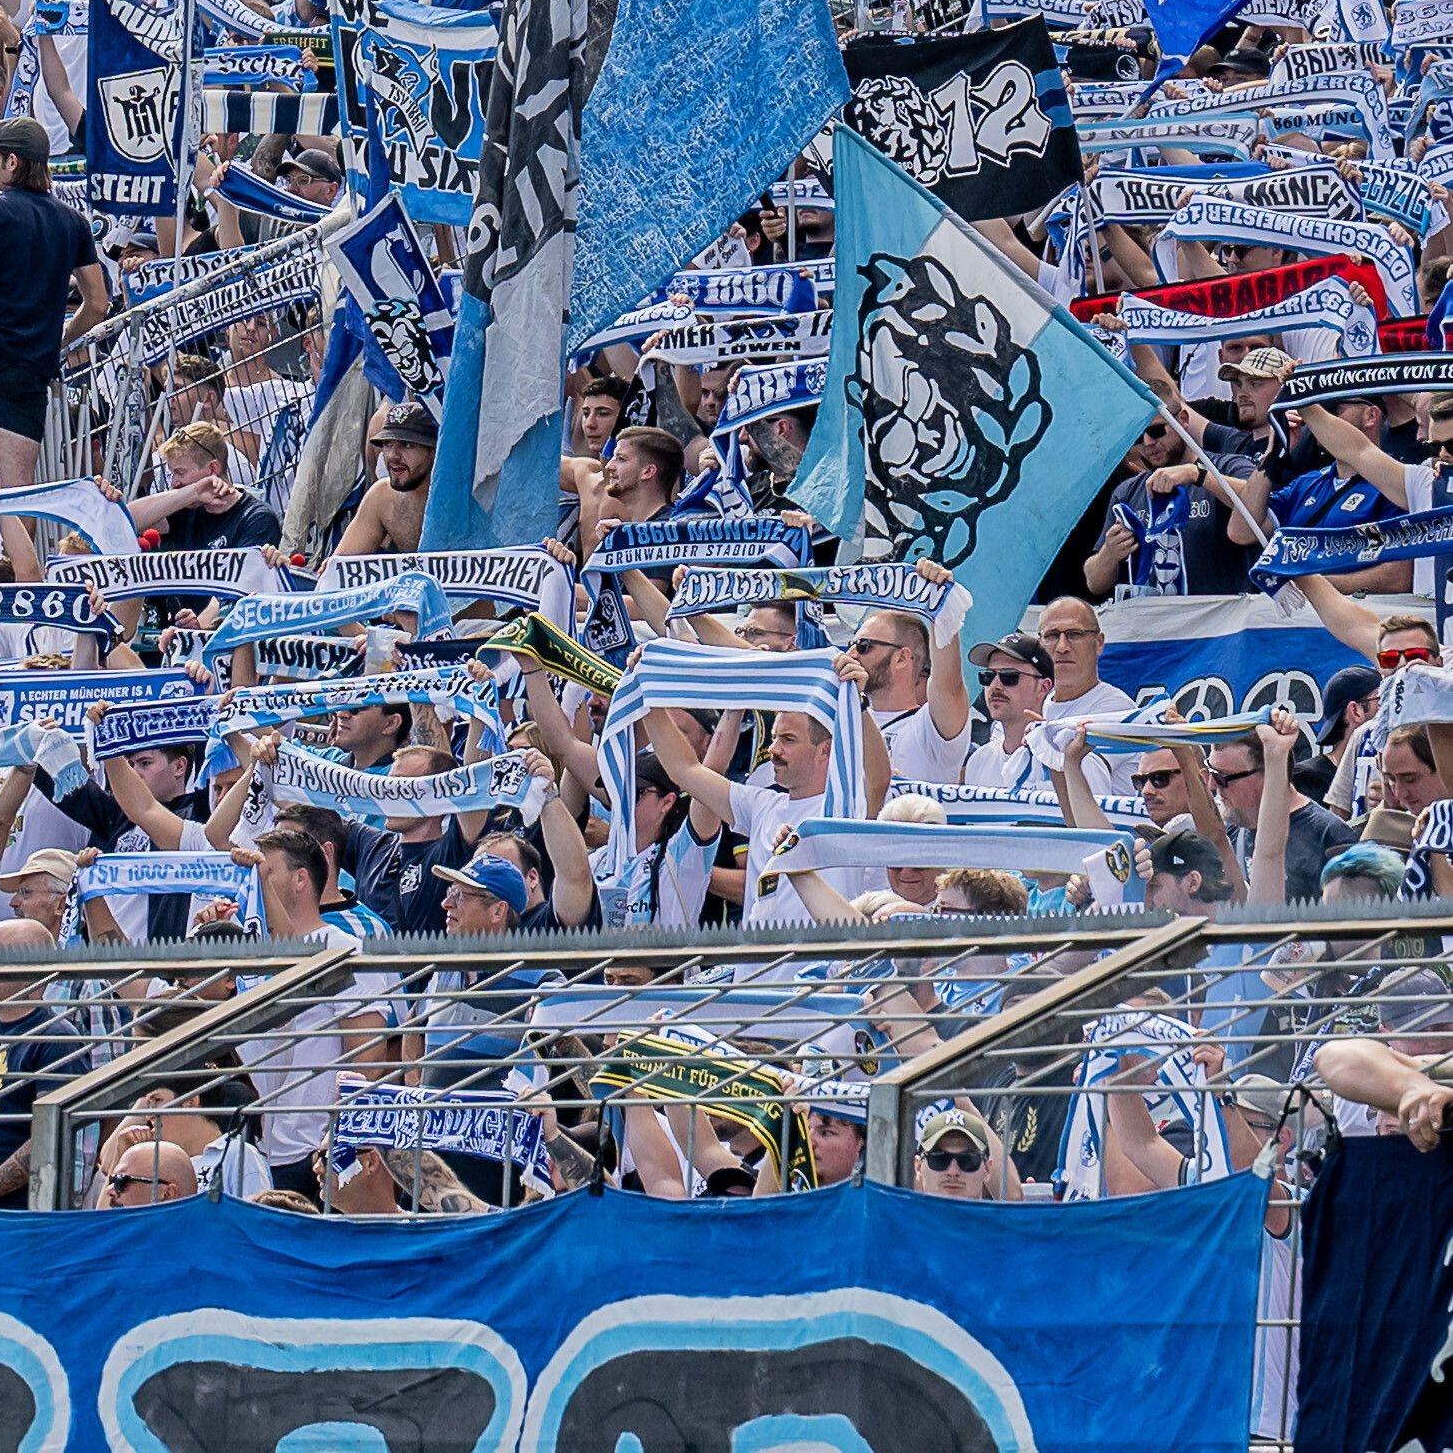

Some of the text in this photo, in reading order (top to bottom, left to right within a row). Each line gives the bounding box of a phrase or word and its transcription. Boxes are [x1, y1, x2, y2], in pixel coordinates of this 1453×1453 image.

[273, 35, 329, 49] FREIHEIT
[1285, 47, 1337, 80] 1860
[1252, 74, 1347, 100] MEISTER
[932, 61, 1052, 177] 12
[417, 150, 479, 194] SIX
[91, 175, 167, 204] STEHT
[1207, 203, 1293, 231] MEISTER
[1286, 365, 1433, 395] TSV MÜNCHEN VON
[621, 521, 687, 545] 1860
[129, 551, 247, 584] MÜNCHEN
[605, 542, 766, 567] GRÜNWALDER STADION
[429, 556, 554, 593] MÜNCHEN
[827, 566, 947, 608] STADION
[233, 591, 383, 631] SECHZIG CLUB DER
[29, 685, 129, 702] ECHTER MÜNCHNER
